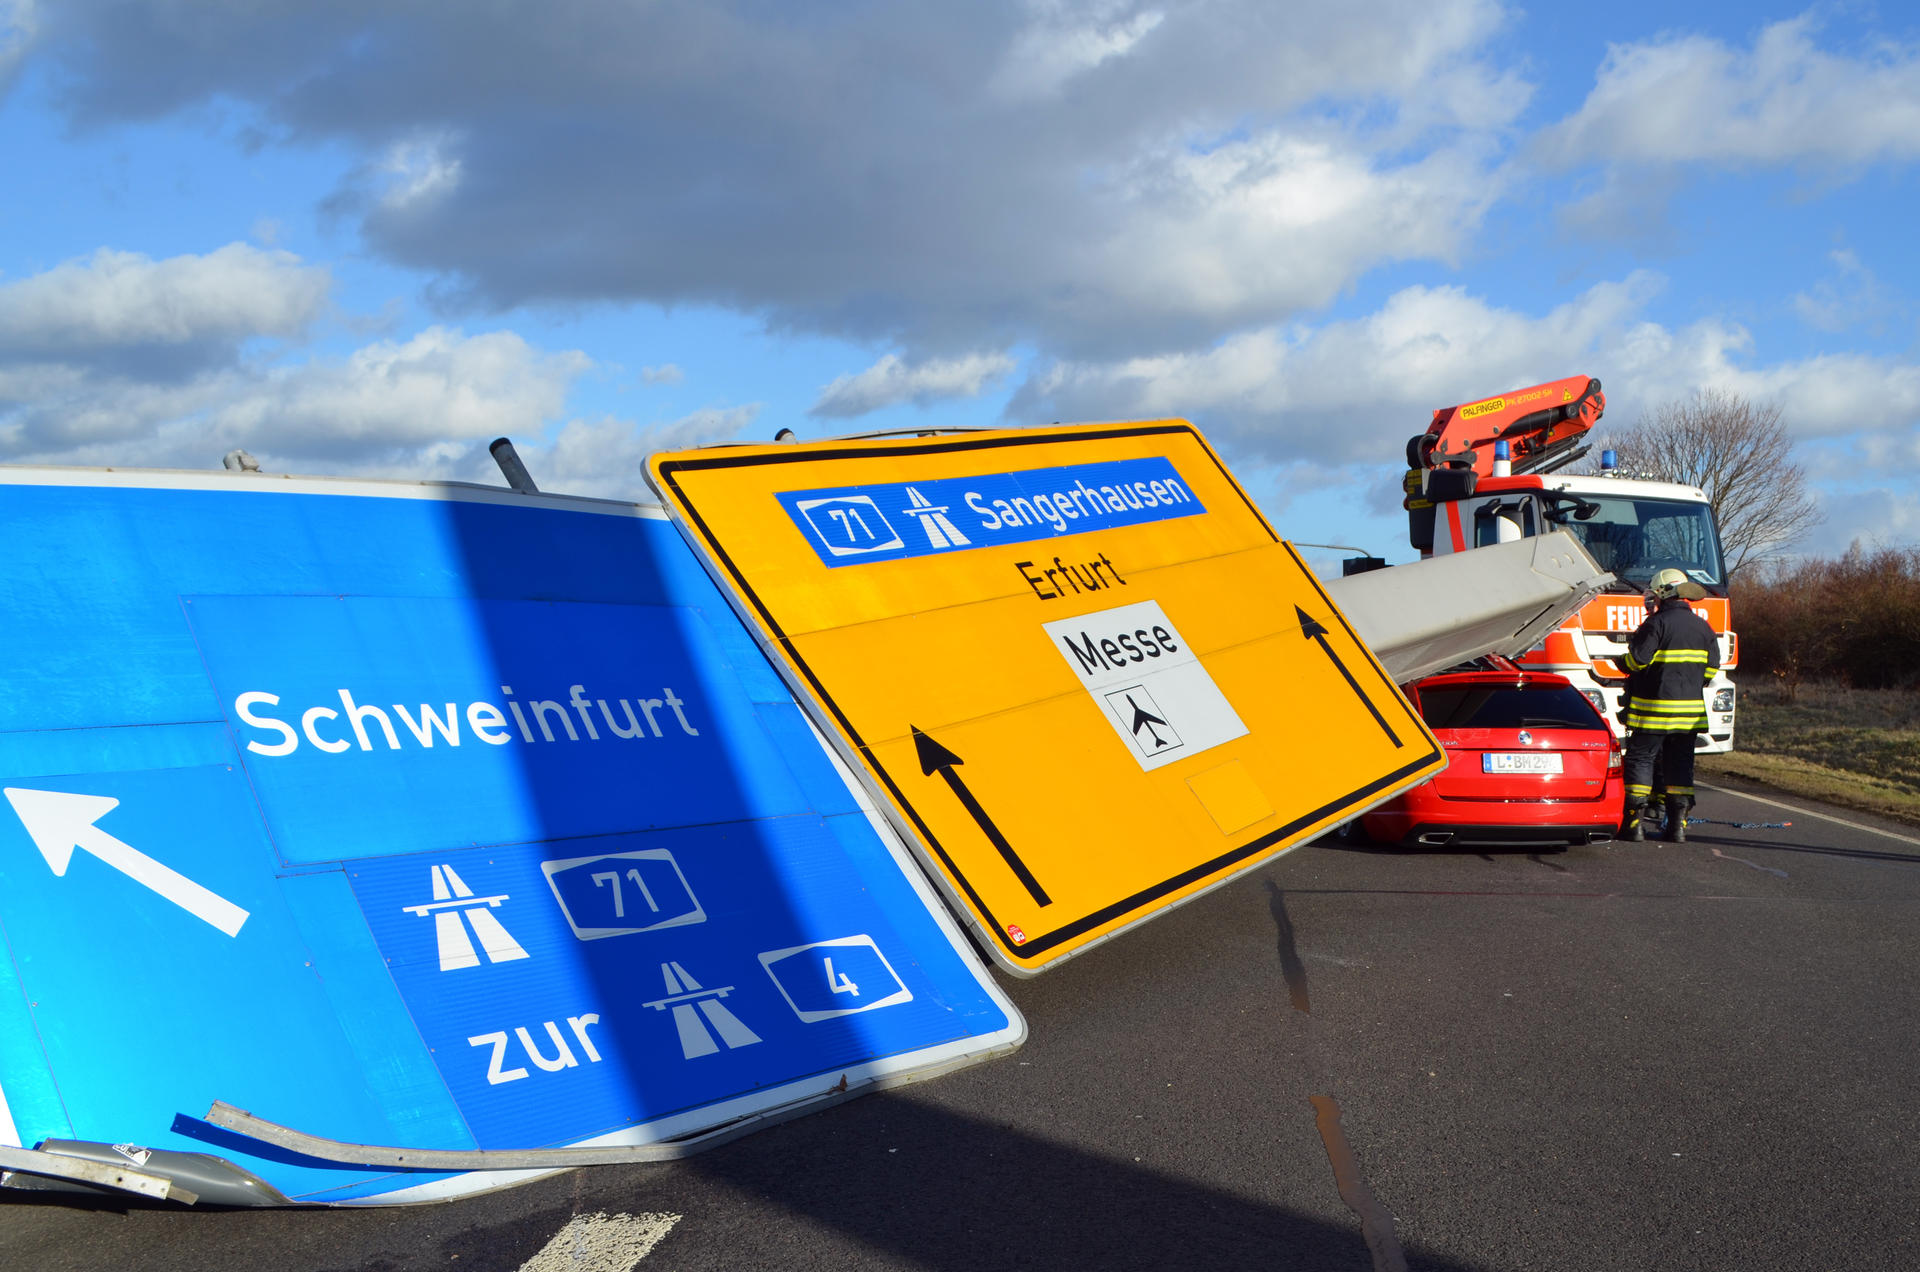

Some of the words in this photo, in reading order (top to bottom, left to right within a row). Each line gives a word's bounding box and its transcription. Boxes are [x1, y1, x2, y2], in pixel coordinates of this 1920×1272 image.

[1462, 399, 1503, 417] PALFINGER
[828, 507, 876, 542] 71
[964, 478, 1190, 532] Sangerhausen
[1014, 552, 1126, 600] Erfurt
[1062, 624, 1178, 676] Messe
[234, 684, 700, 757] Schweinfurt
[590, 868, 659, 918] 71
[467, 1012, 602, 1086] zur
[823, 956, 860, 997] 4
